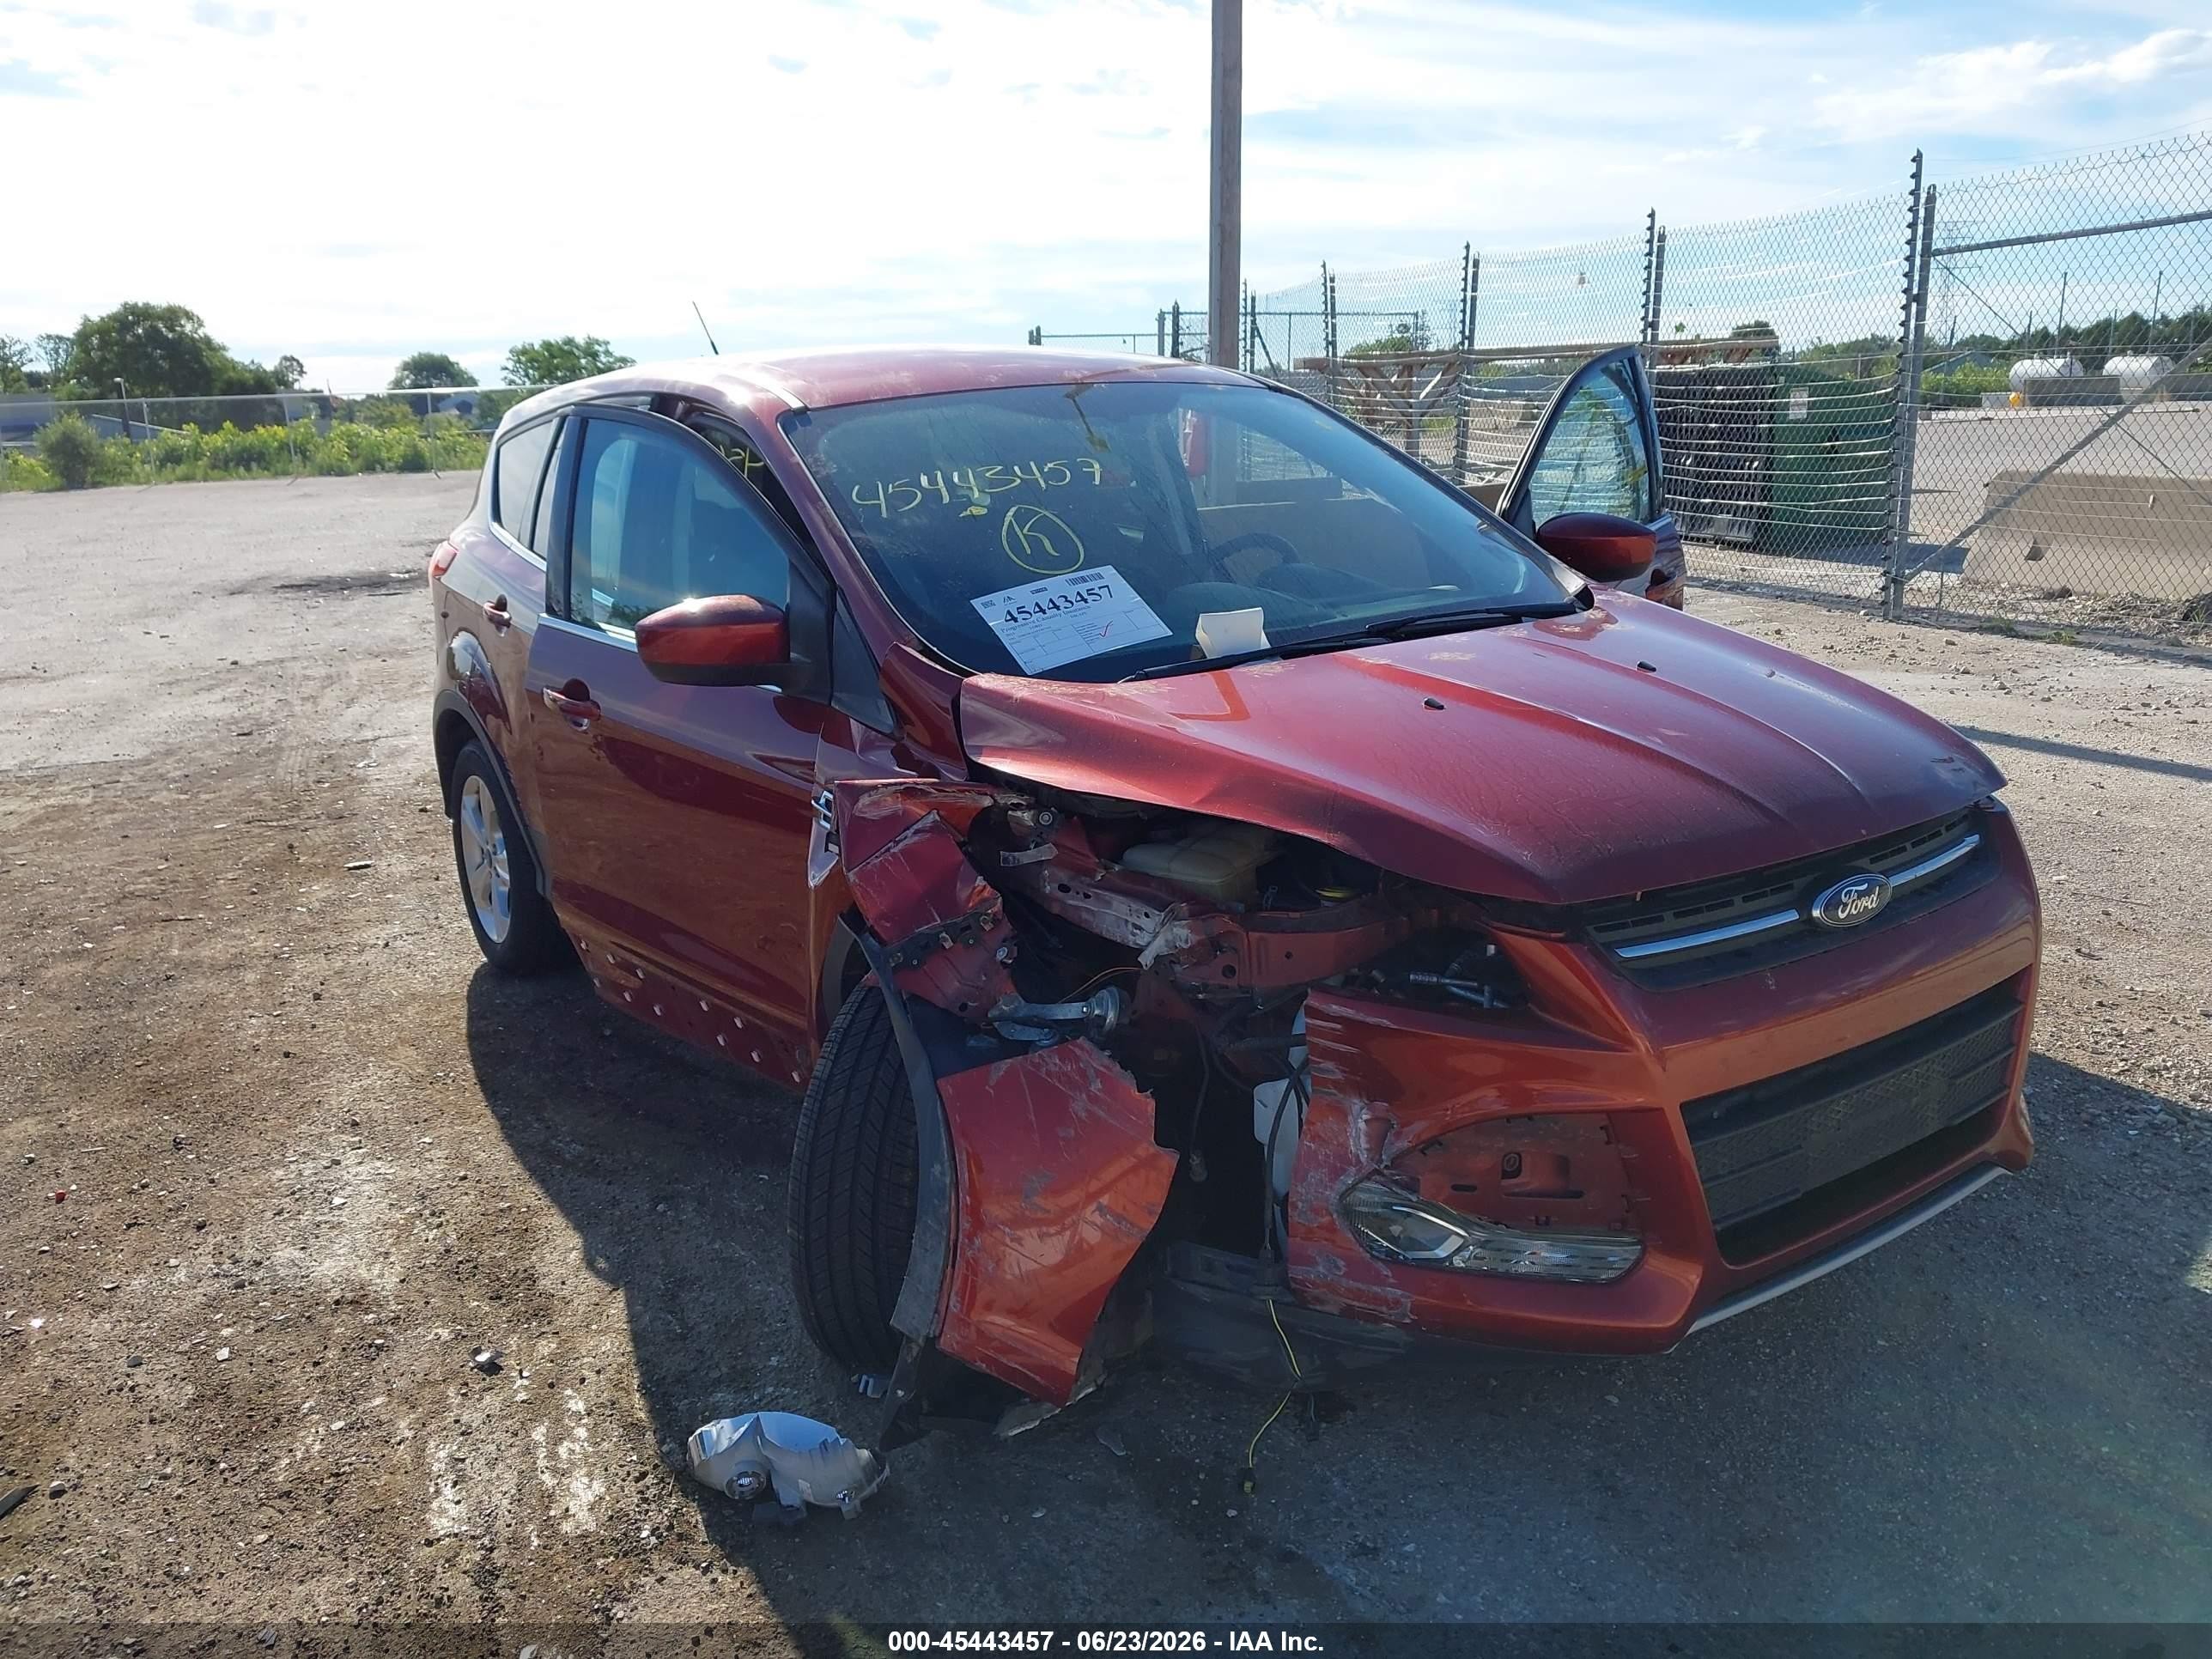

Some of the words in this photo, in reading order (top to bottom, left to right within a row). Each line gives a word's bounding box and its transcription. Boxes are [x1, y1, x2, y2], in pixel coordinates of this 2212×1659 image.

[851, 458, 1103, 518] 45443457
[1004, 585, 1114, 624] 45443457
[1838, 883, 1880, 919] Ford
